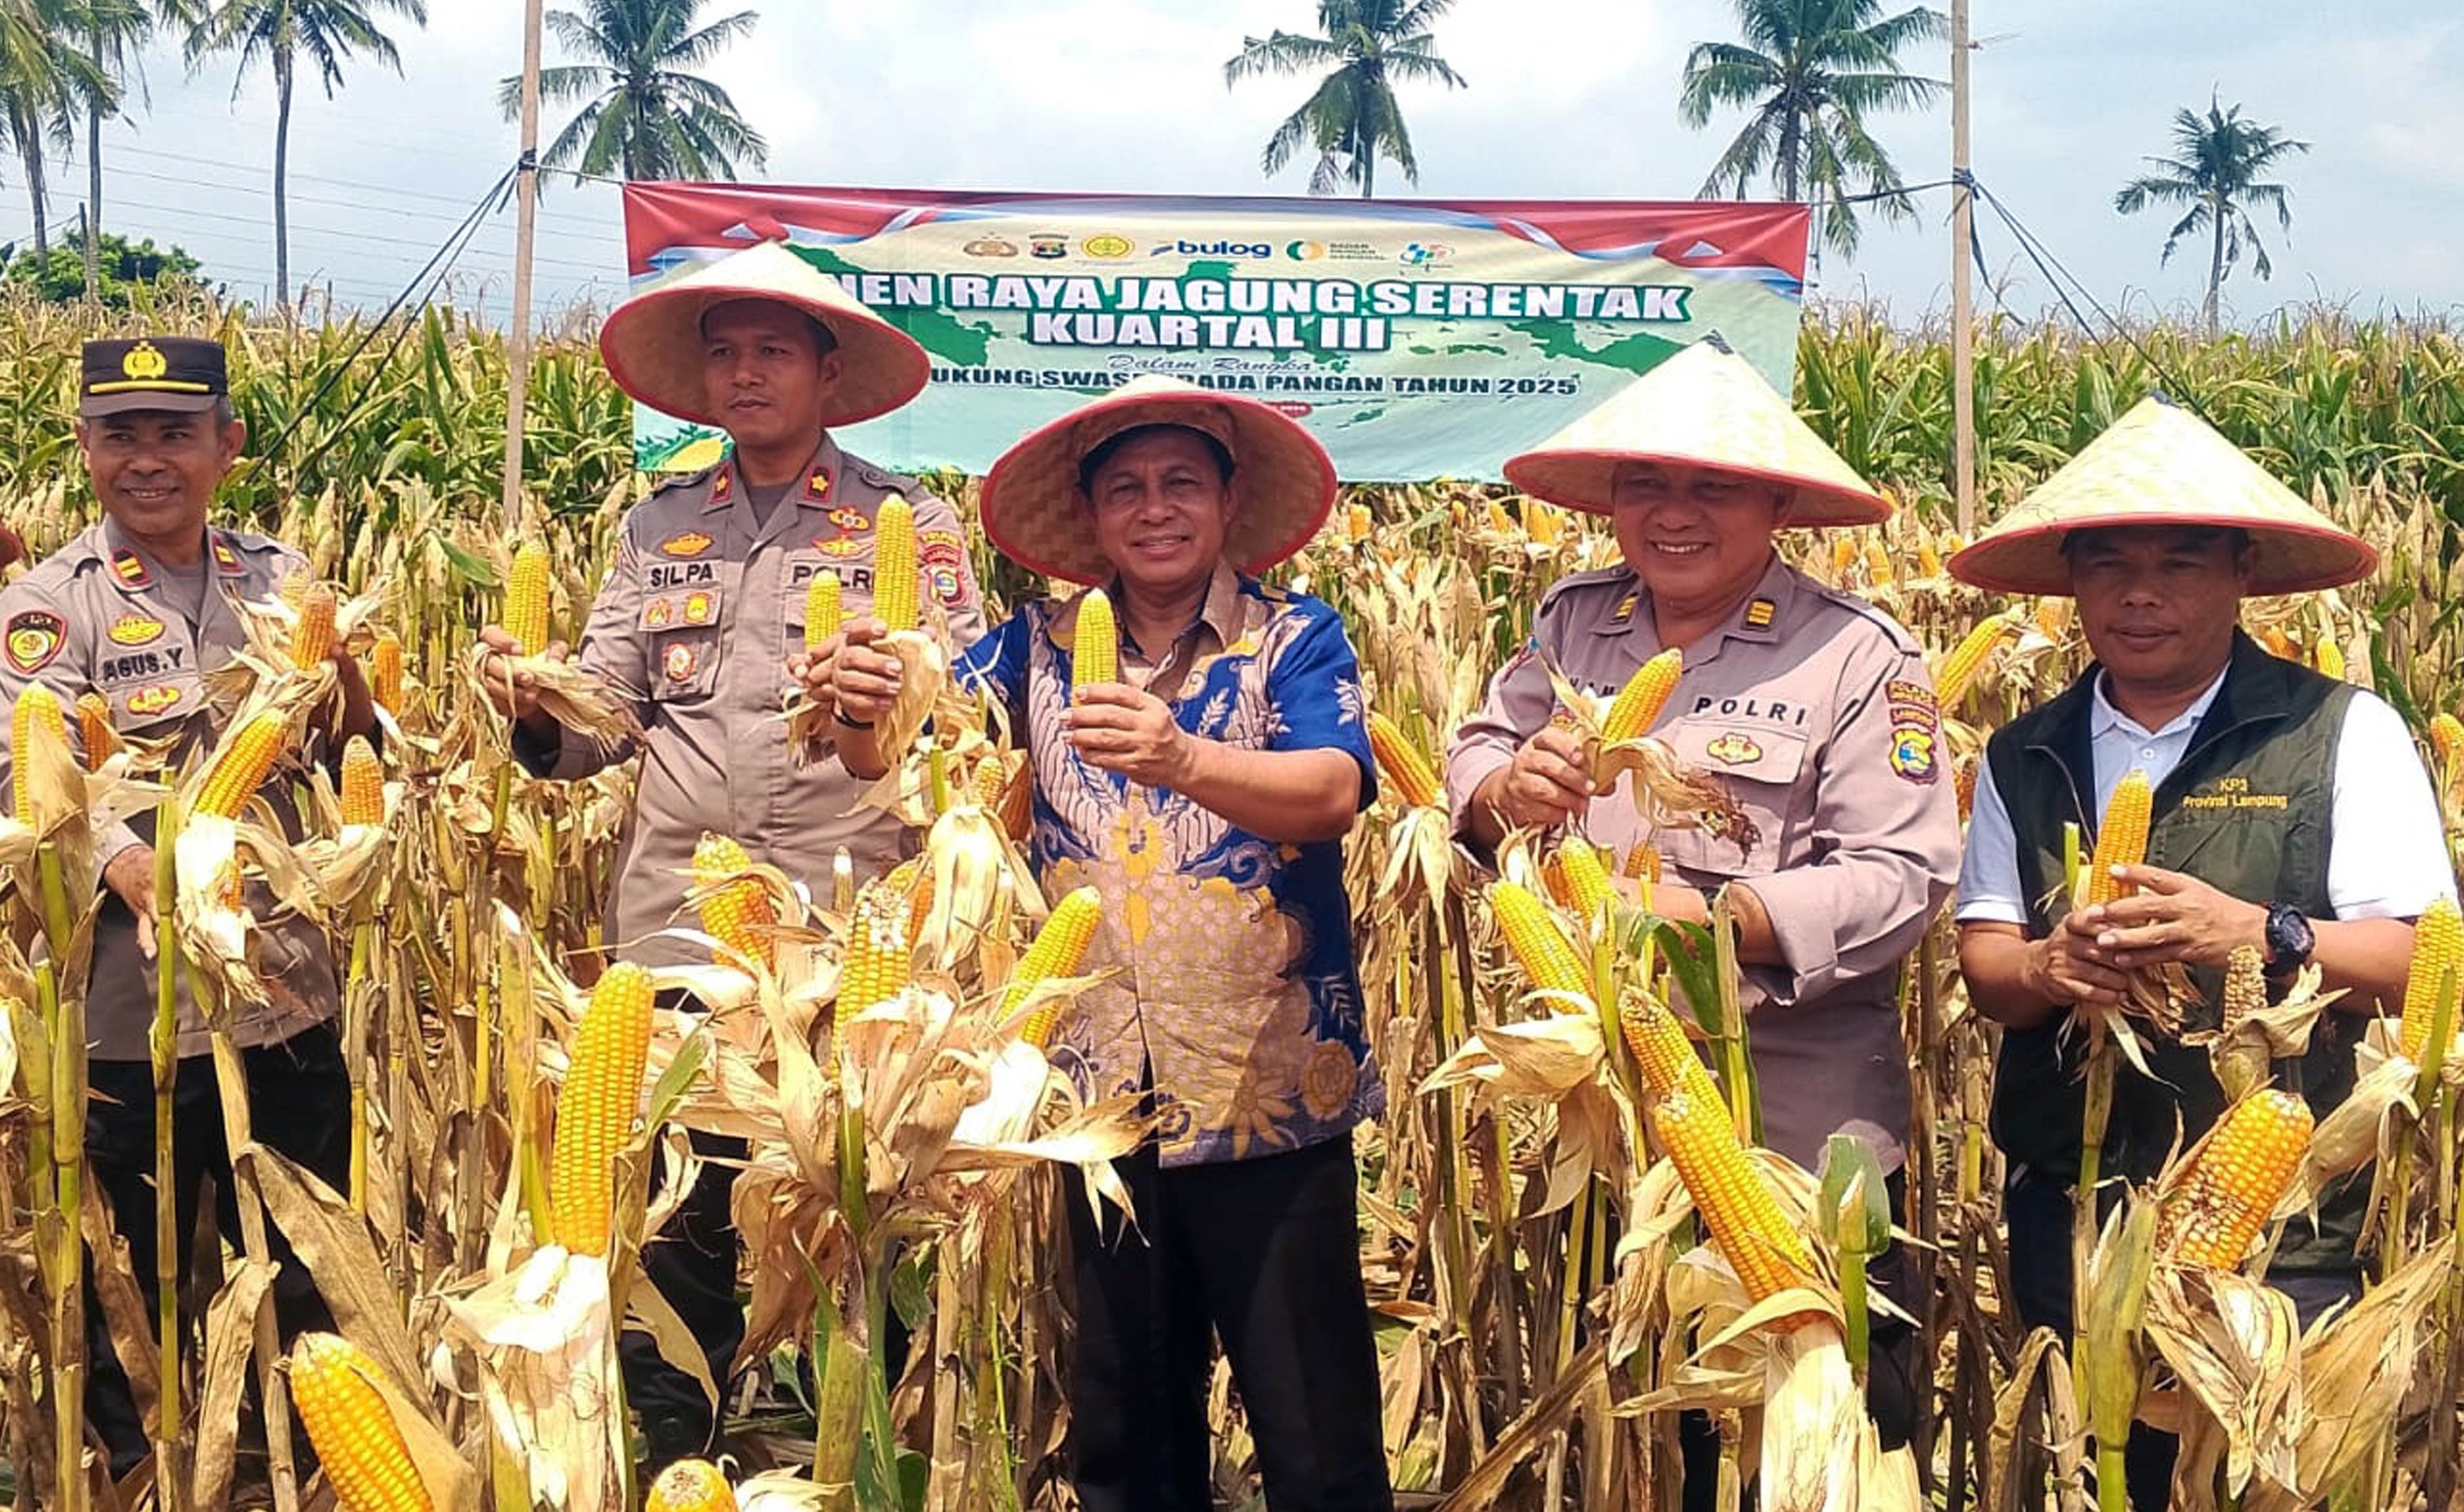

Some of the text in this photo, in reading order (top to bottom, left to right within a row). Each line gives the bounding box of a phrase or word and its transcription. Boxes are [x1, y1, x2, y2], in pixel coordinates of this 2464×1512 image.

[1178, 240, 1272, 257] bulog
[952, 276, 1101, 309] RAYA
[1116, 277, 1357, 313] JAGUNG
[1374, 284, 1689, 319] SERENTAK
[1033, 312, 1387, 349] KUARTAL III
[1107, 354, 1316, 374] Dalam Rangka
[1266, 375, 1383, 392] PANGAN
[1392, 376, 1489, 394] TAHUN
[1497, 377, 1577, 395] 2025
[651, 563, 713, 587] SILPA
[103, 647, 184, 682] AGUS.Y
[1694, 697, 1807, 726] POLRI
